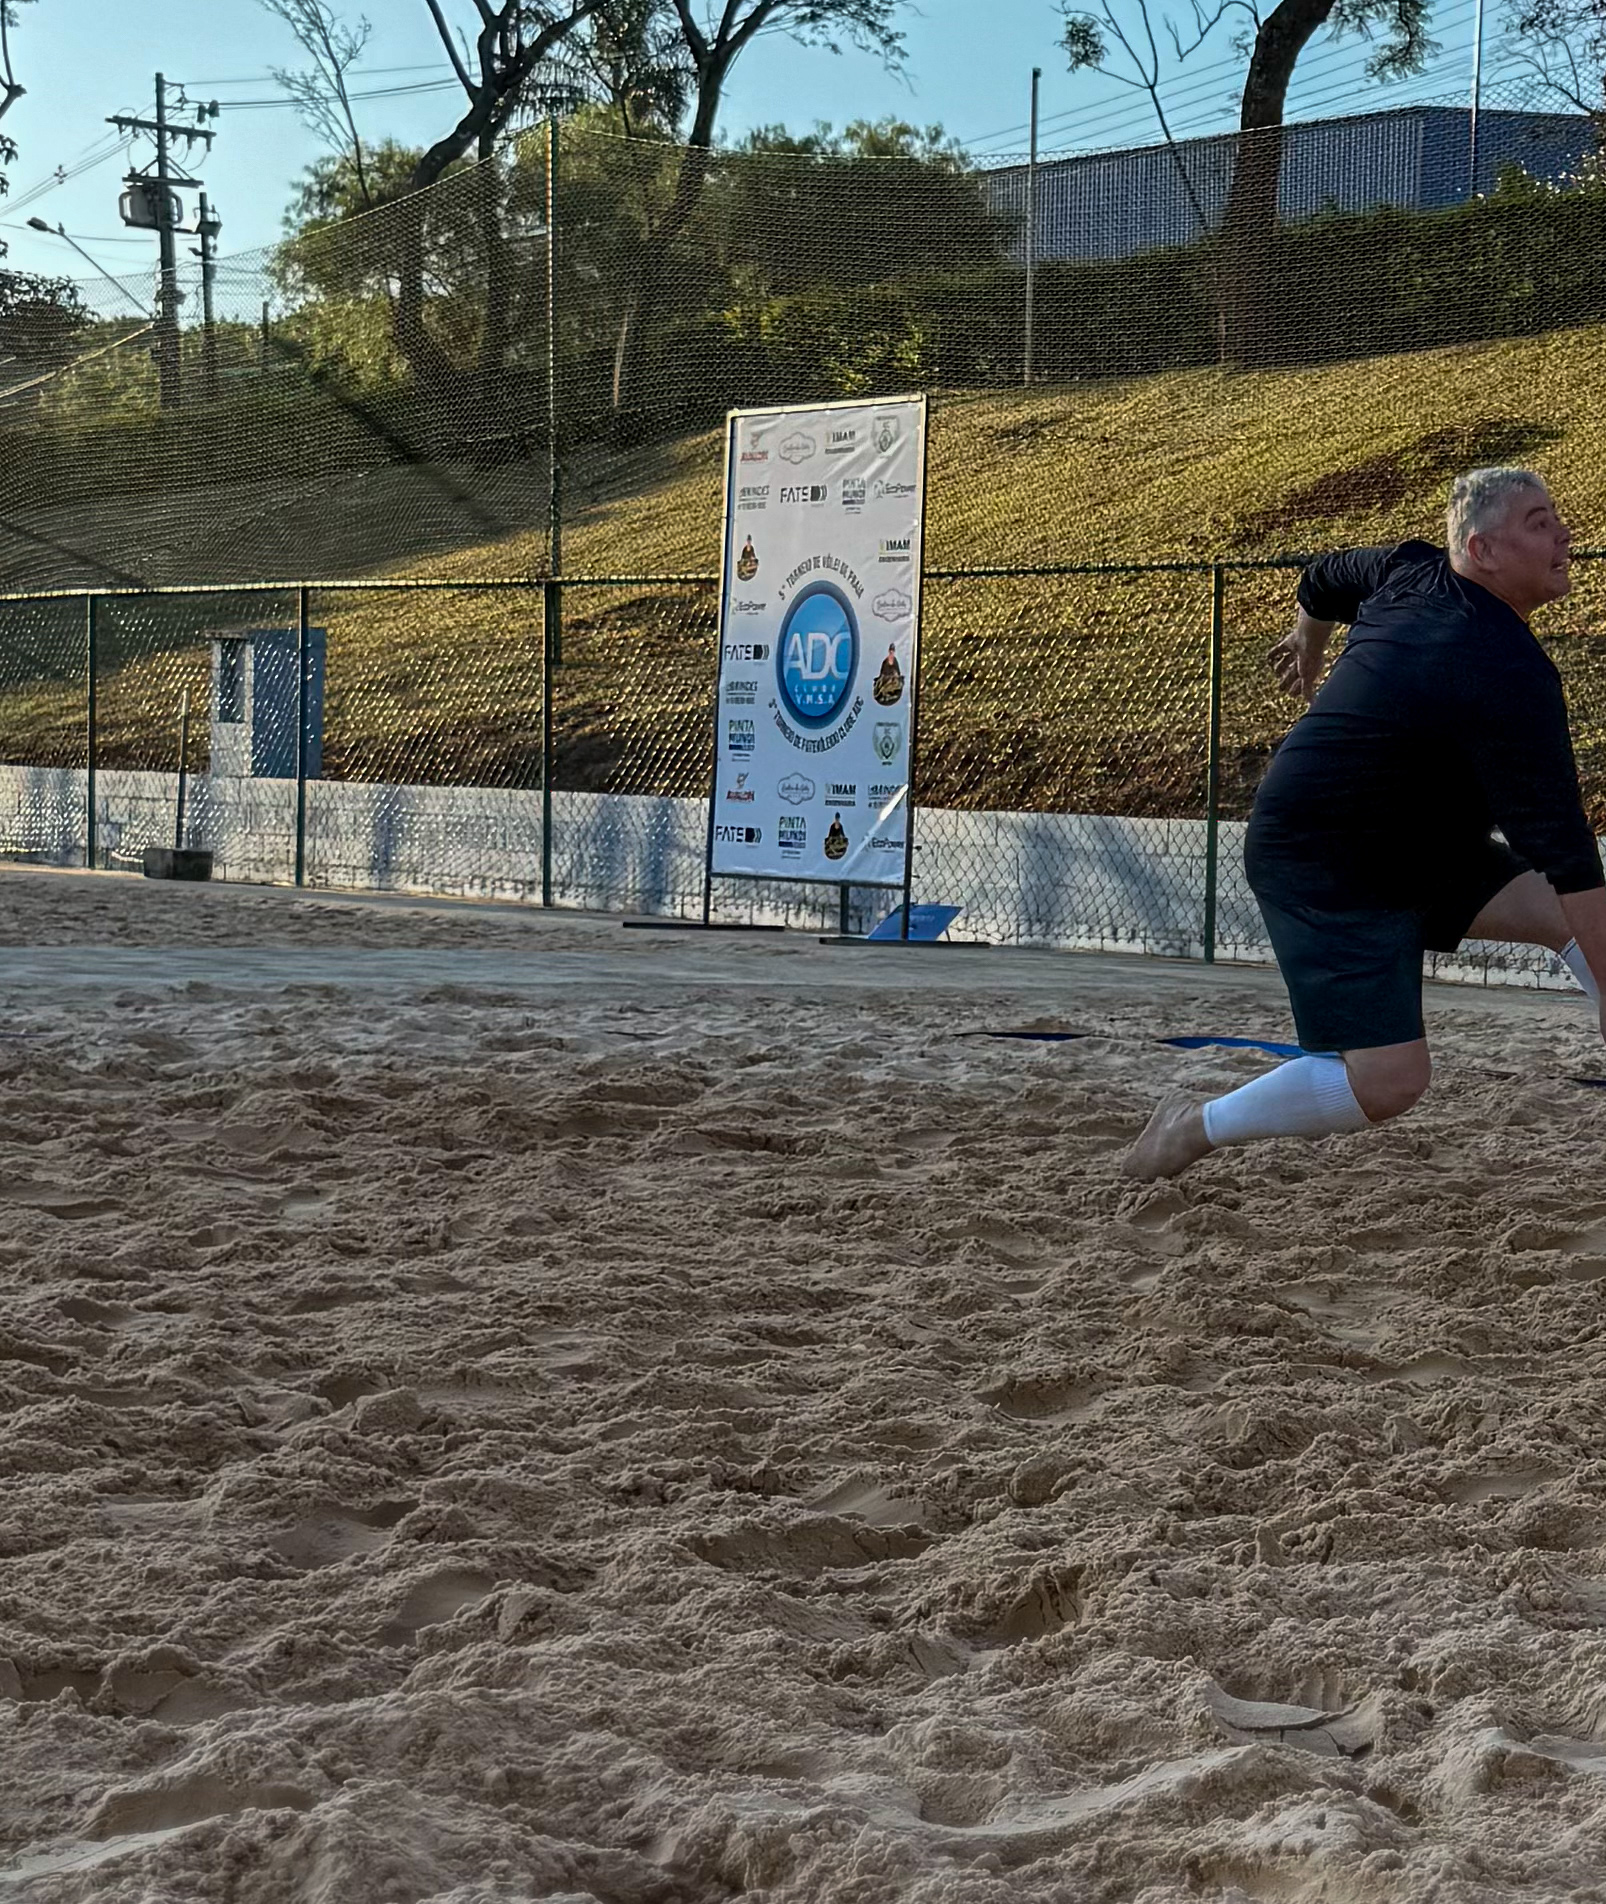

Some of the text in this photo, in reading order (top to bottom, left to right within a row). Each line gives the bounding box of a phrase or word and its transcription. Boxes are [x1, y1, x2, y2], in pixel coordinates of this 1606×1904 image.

[847, 569, 864, 600] PRAIA
[783, 632, 851, 680] ADC
[779, 816, 806, 829] PINTA
